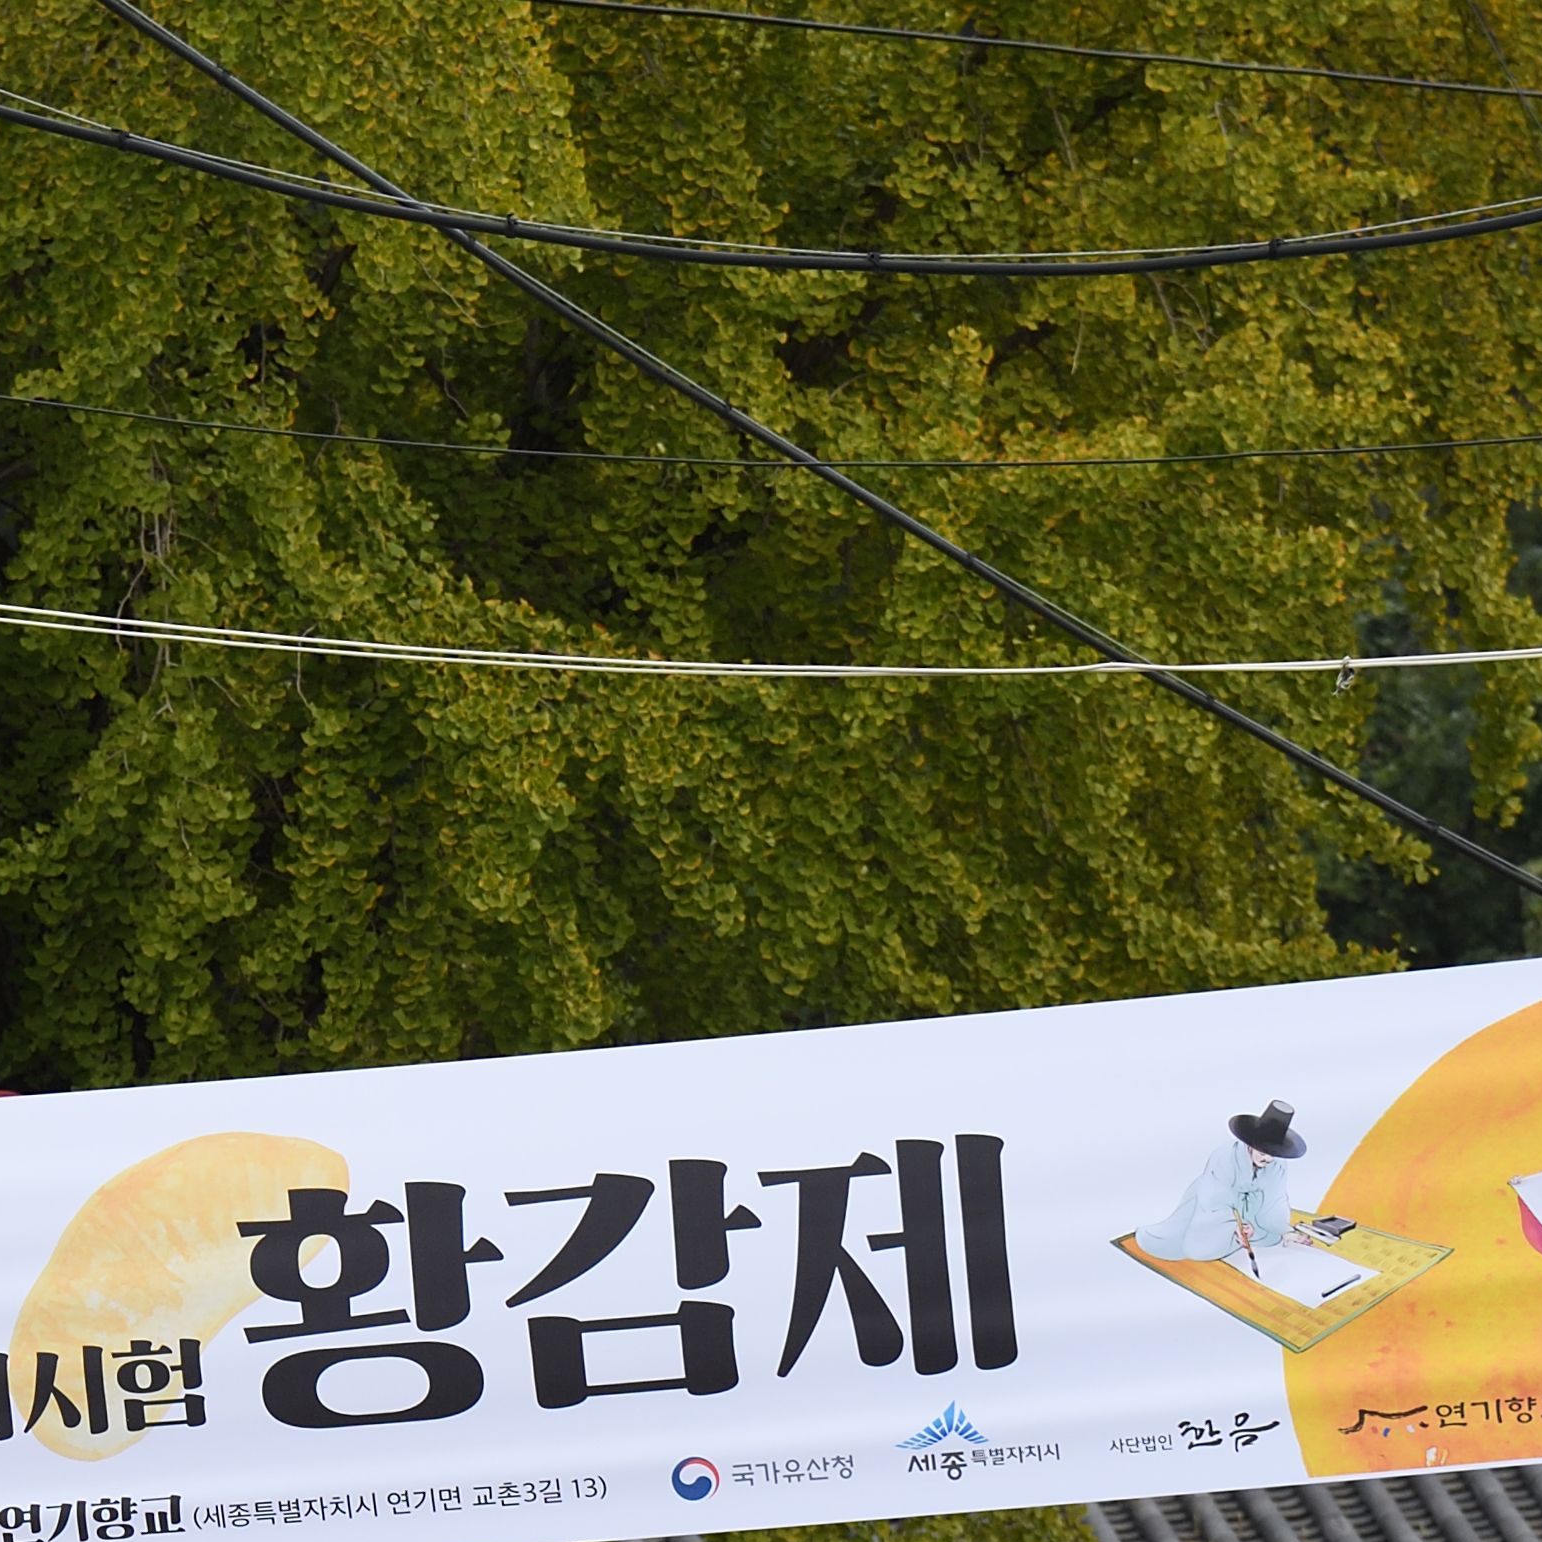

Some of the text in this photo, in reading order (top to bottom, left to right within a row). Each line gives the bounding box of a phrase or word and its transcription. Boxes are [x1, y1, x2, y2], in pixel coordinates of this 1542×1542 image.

[236, 1134, 1018, 1430] 황감제
[1110, 1413, 1280, 1453] 사단법인 한음
[732, 1455, 854, 1486] 국가유산청
[387, 1486, 462, 1515] 연기면
[473, 1478, 562, 1506] 교촌3길
[572, 1476, 607, 1500] 13)
